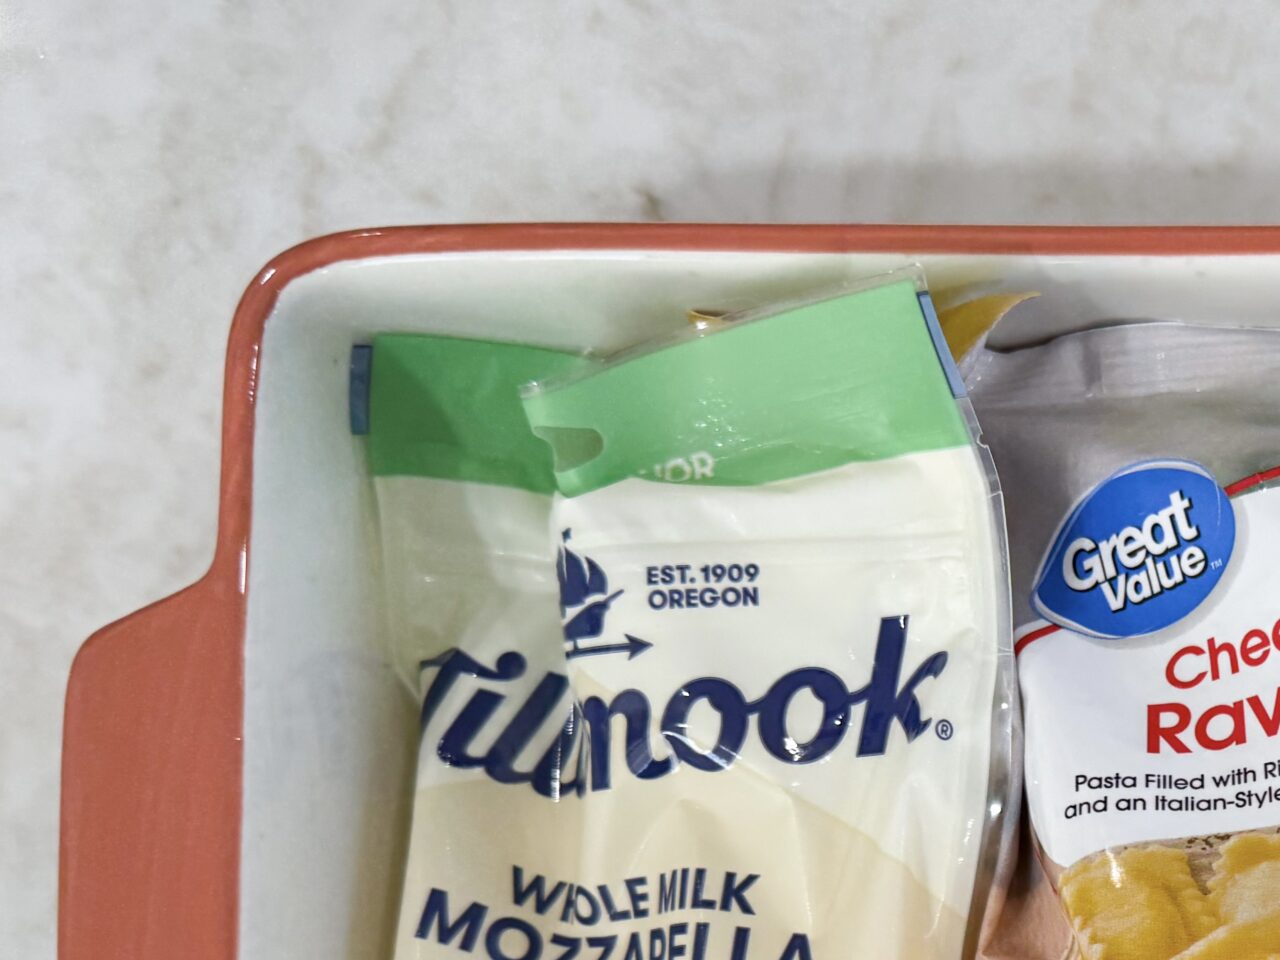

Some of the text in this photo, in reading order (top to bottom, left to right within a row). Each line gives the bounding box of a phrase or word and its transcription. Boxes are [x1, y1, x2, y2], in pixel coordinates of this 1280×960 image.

[1062, 489, 1200, 592] Great
[646, 563, 760, 585] EST. 1909
[1100, 547, 1207, 612] Value
[648, 586, 760, 610] OREGON
[1074, 772, 1137, 792] Pasta
[1144, 772, 1205, 791] Filled
[1212, 767, 1257, 791] with
[1064, 796, 1108, 820] and
[1116, 797, 1146, 812] an
[658, 867, 761, 916] MILK
